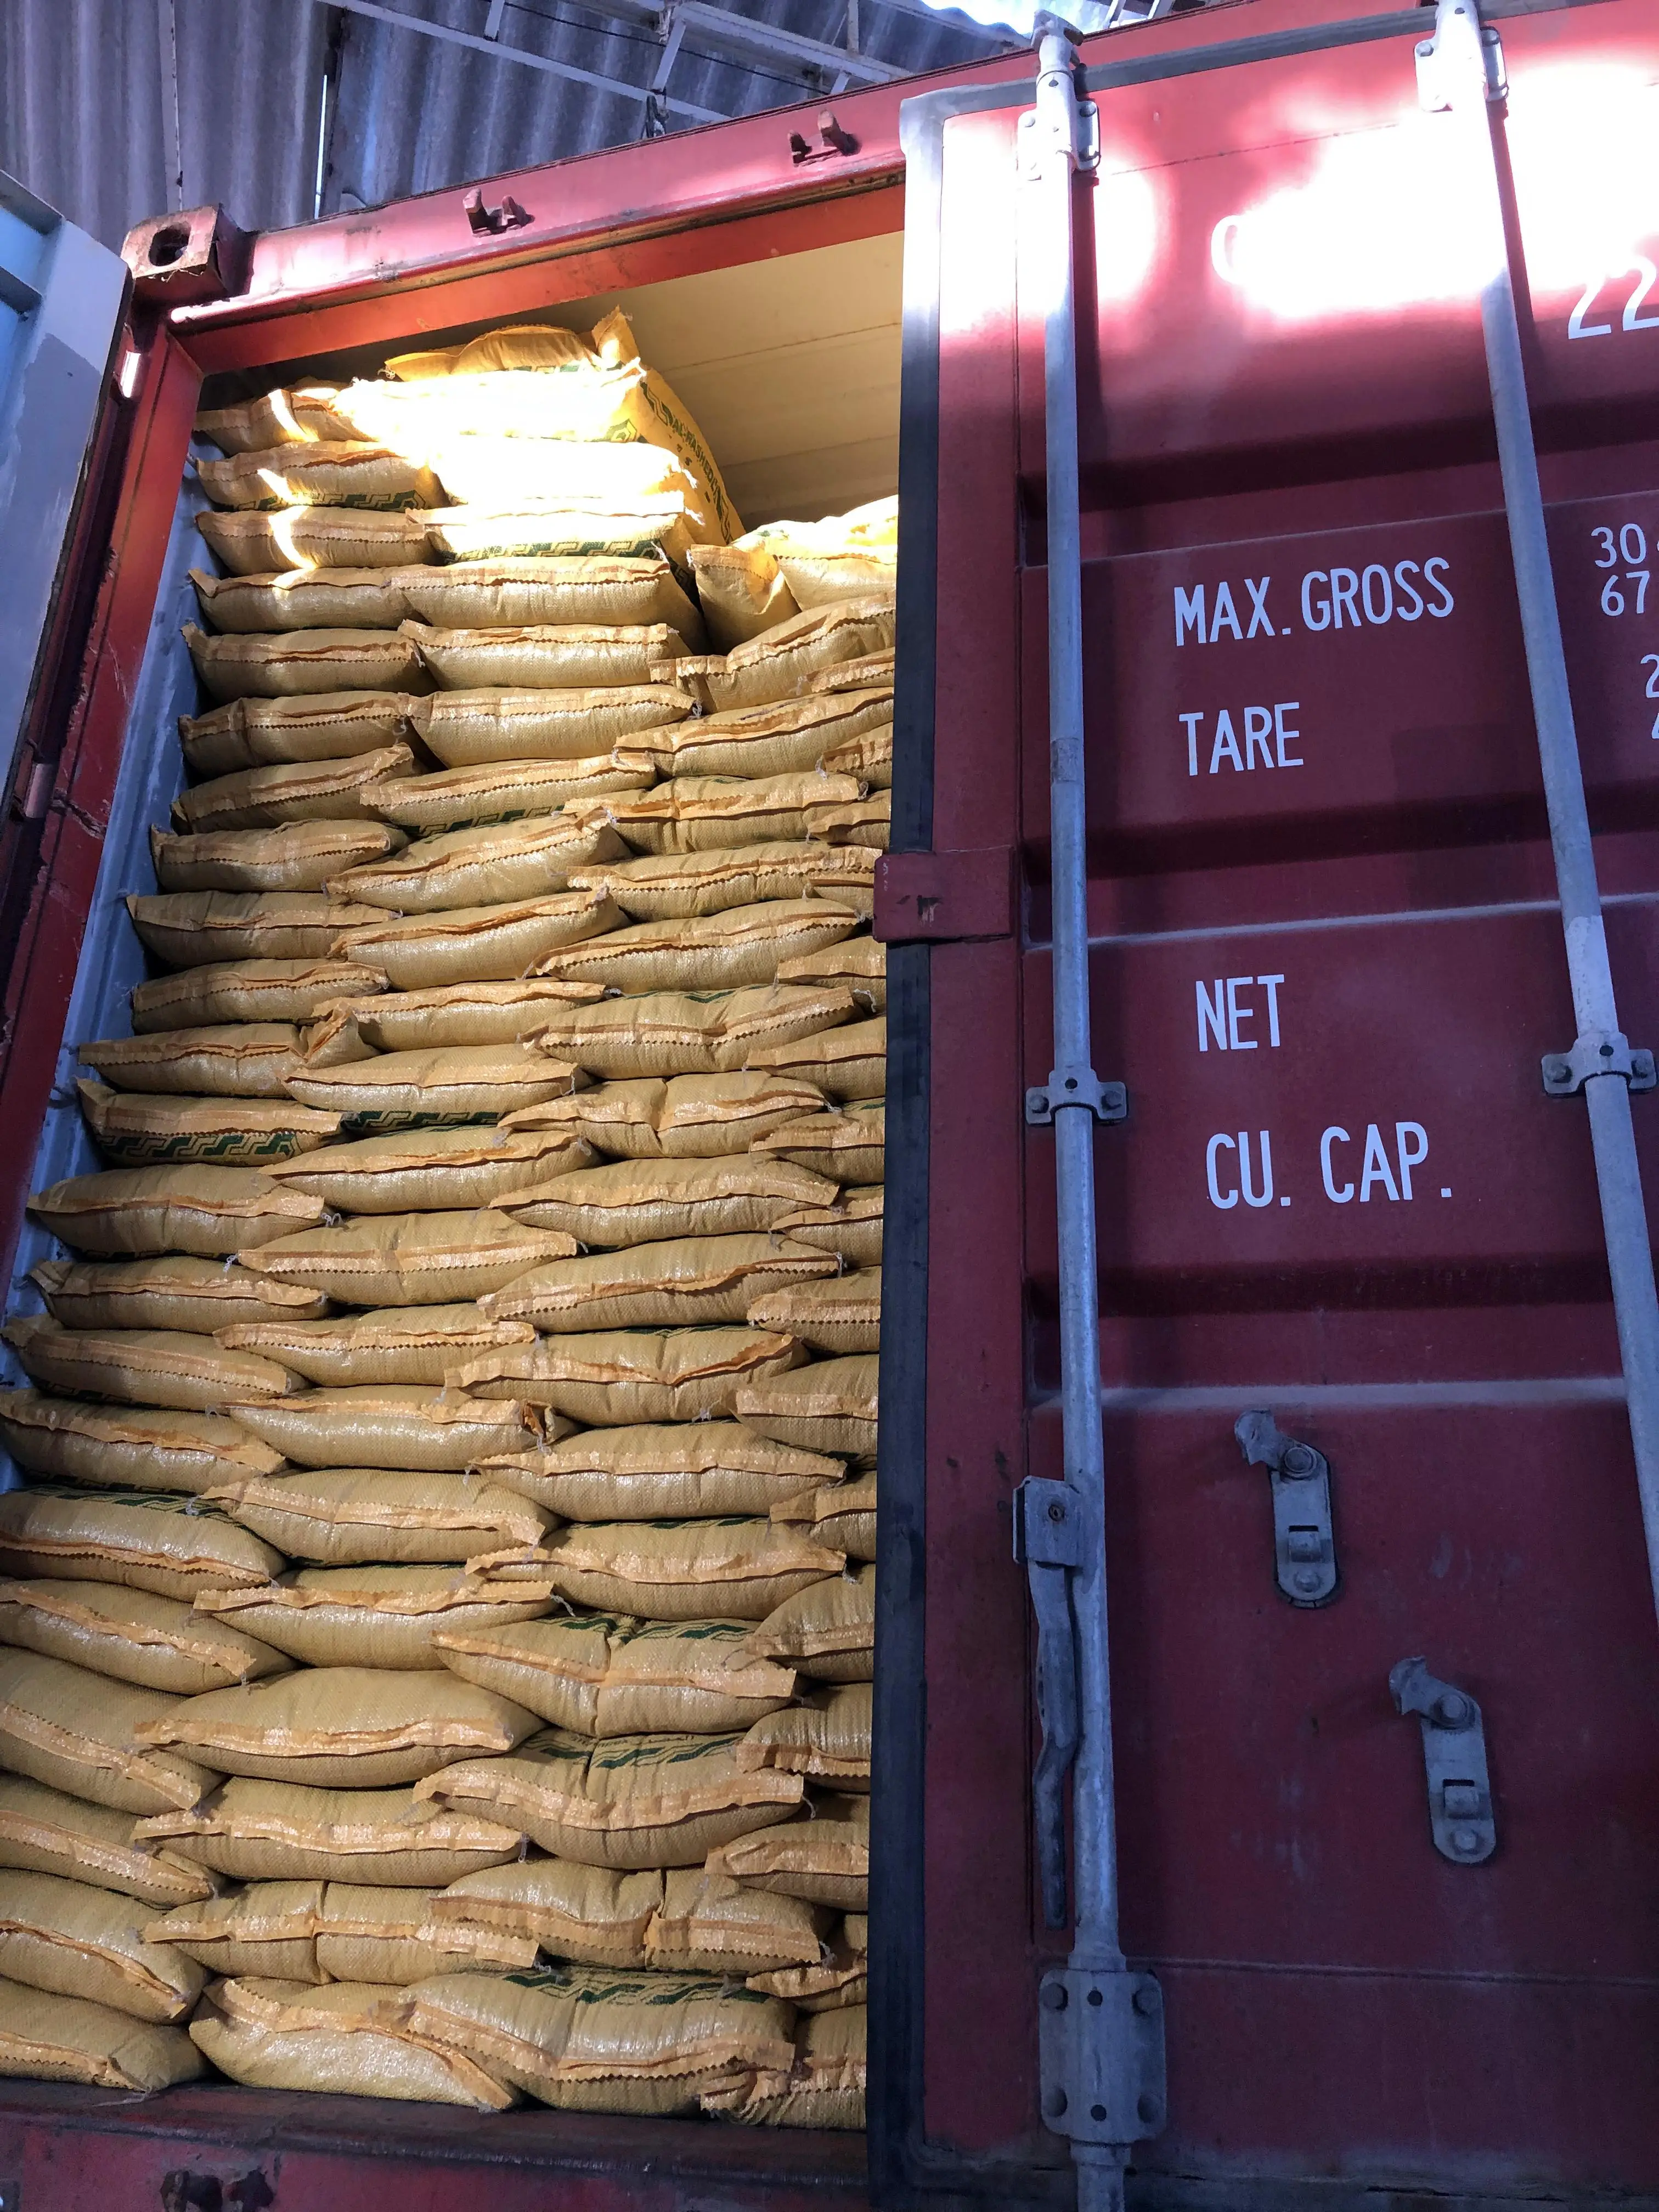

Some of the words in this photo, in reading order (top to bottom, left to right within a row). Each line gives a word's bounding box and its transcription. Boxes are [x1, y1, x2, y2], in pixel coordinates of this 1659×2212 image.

[1601, 571, 1650, 616] 67
[1179, 702, 1304, 776] TARE
[1195, 974, 1285, 1052] NET
[1206, 1130, 1291, 1209] CU.
[1321, 1121, 1452, 1203] CAP.
